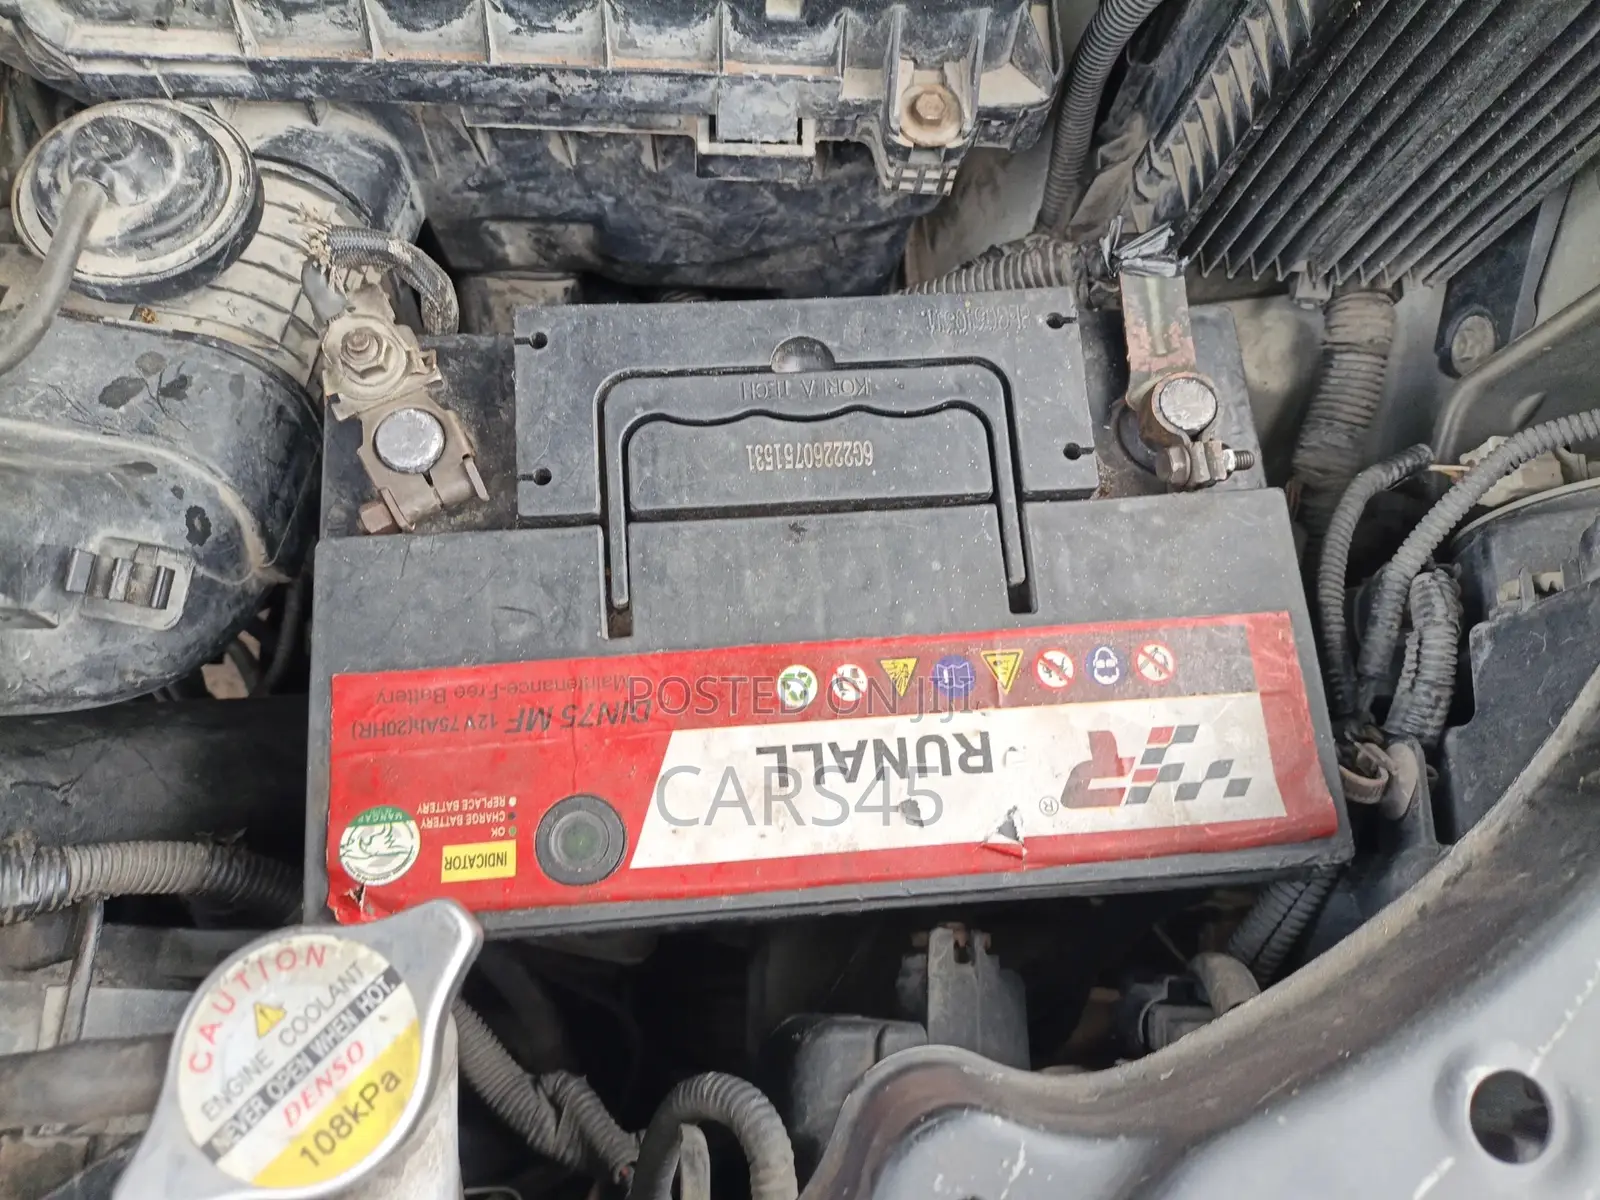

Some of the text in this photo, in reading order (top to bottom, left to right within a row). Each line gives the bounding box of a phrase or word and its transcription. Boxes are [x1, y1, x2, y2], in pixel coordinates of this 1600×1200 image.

[351, 699, 651, 740] DIN75 MF 12V 75Ah(20HR)
[376, 688, 446, 706] Battery
[756, 731, 994, 788] RUNALL
[417, 796, 506, 814] REPLACE BATTERY
[420, 811, 506, 829] CHARGE BATTERY
[490, 827, 506, 837] OK
[444, 851, 508, 871] INDICATOR
[188, 944, 327, 1075] CAUTION
[200, 961, 367, 1123] ENGINE COOLANT
[266, 1058, 314, 1100] OPEN
[309, 1009, 358, 1059] WHEN
[281, 1040, 366, 1129] DENSO
[299, 1070, 402, 1167] 108kPa
